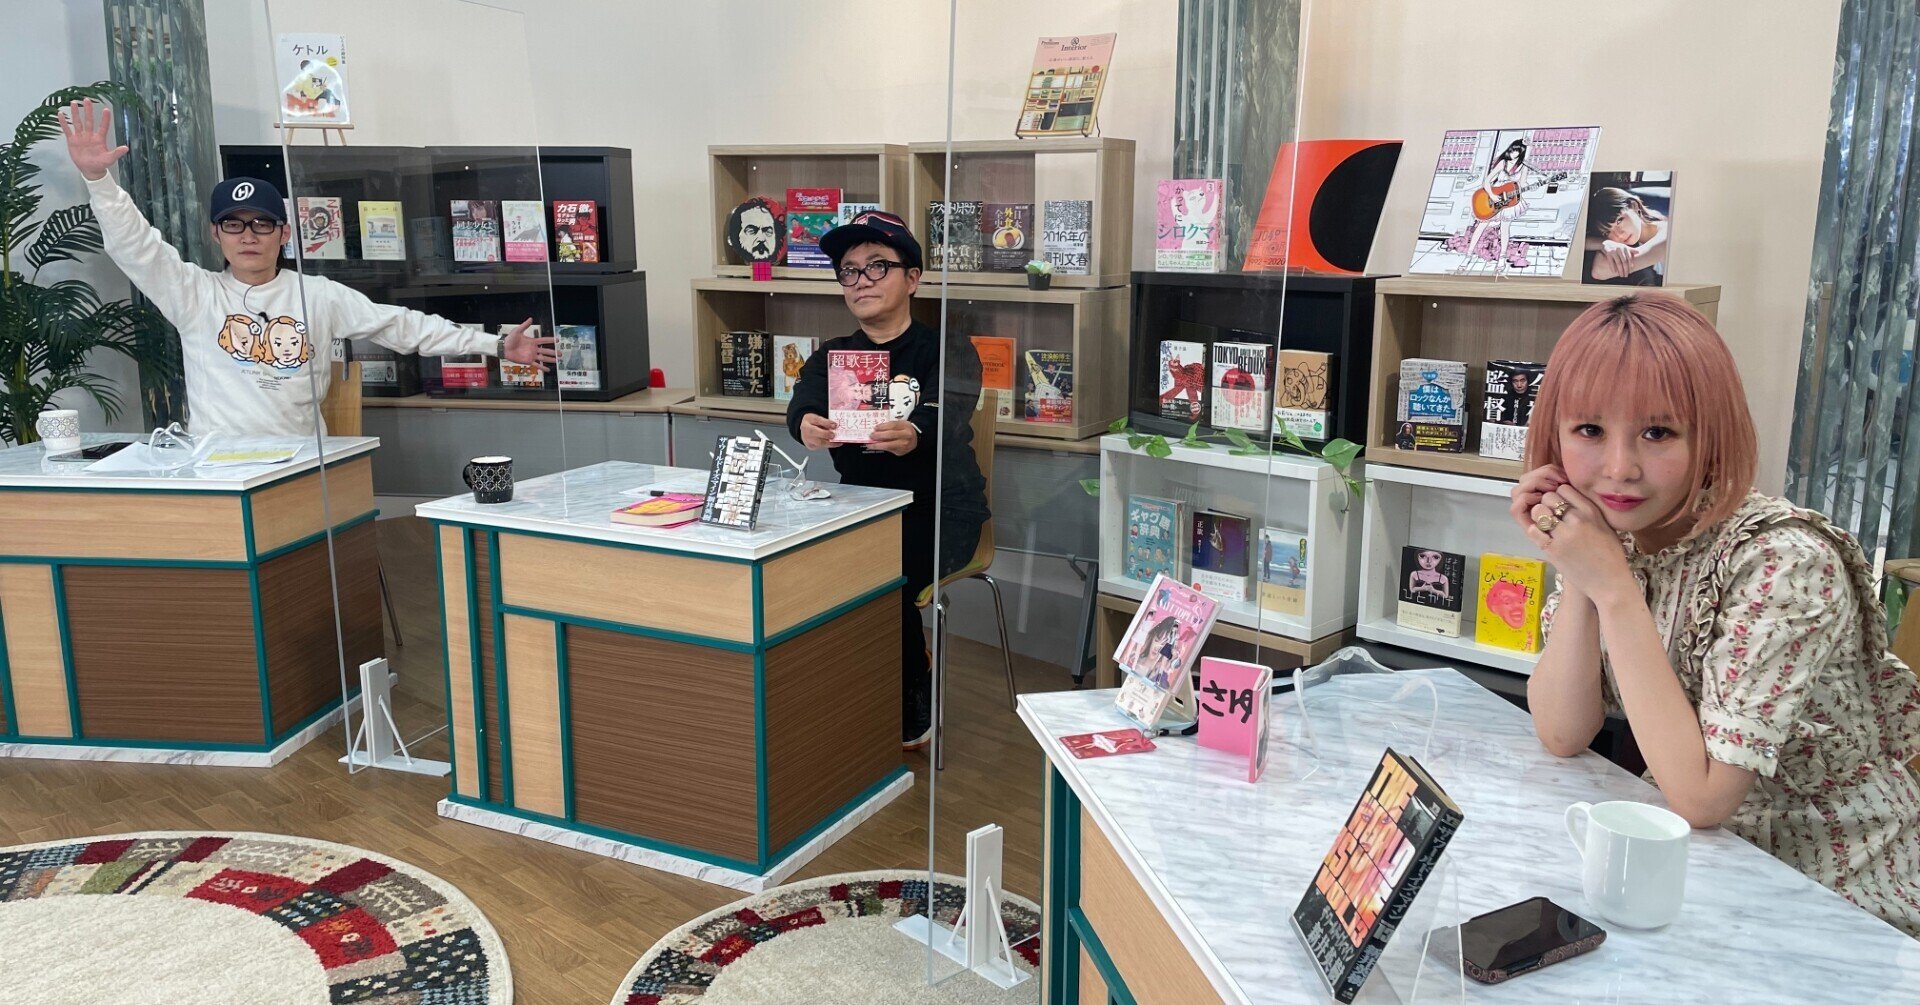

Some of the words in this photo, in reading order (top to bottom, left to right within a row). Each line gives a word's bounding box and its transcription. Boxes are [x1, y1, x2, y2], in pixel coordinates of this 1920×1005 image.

[292, 44, 328, 55] ケトル
[556, 203, 579, 213] 力石
[930, 202, 976, 214] テストリポカ
[1174, 186, 1185, 223] かってに
[1004, 207, 1014, 228] 外食
[1013, 208, 1022, 228] 日本
[1043, 230, 1089, 242] 2016年の
[1157, 223, 1215, 240] シロクマ
[720, 333, 734, 364] 監督
[1214, 345, 1239, 364] TOKYO
[747, 333, 764, 394] 嫌われた
[831, 354, 874, 368] 超歌手
[1238, 356, 1265, 375] REDUX
[874, 354, 889, 410] 大森靖子
[1422, 385, 1439, 394] 僕は
[1410, 394, 1451, 403] ロックなんか
[1484, 370, 1509, 421] 監督
[1412, 403, 1451, 413] 聴いてきた
[1139, 523, 1160, 539] 辞典
[1402, 588, 1454, 607] ひとかげ
